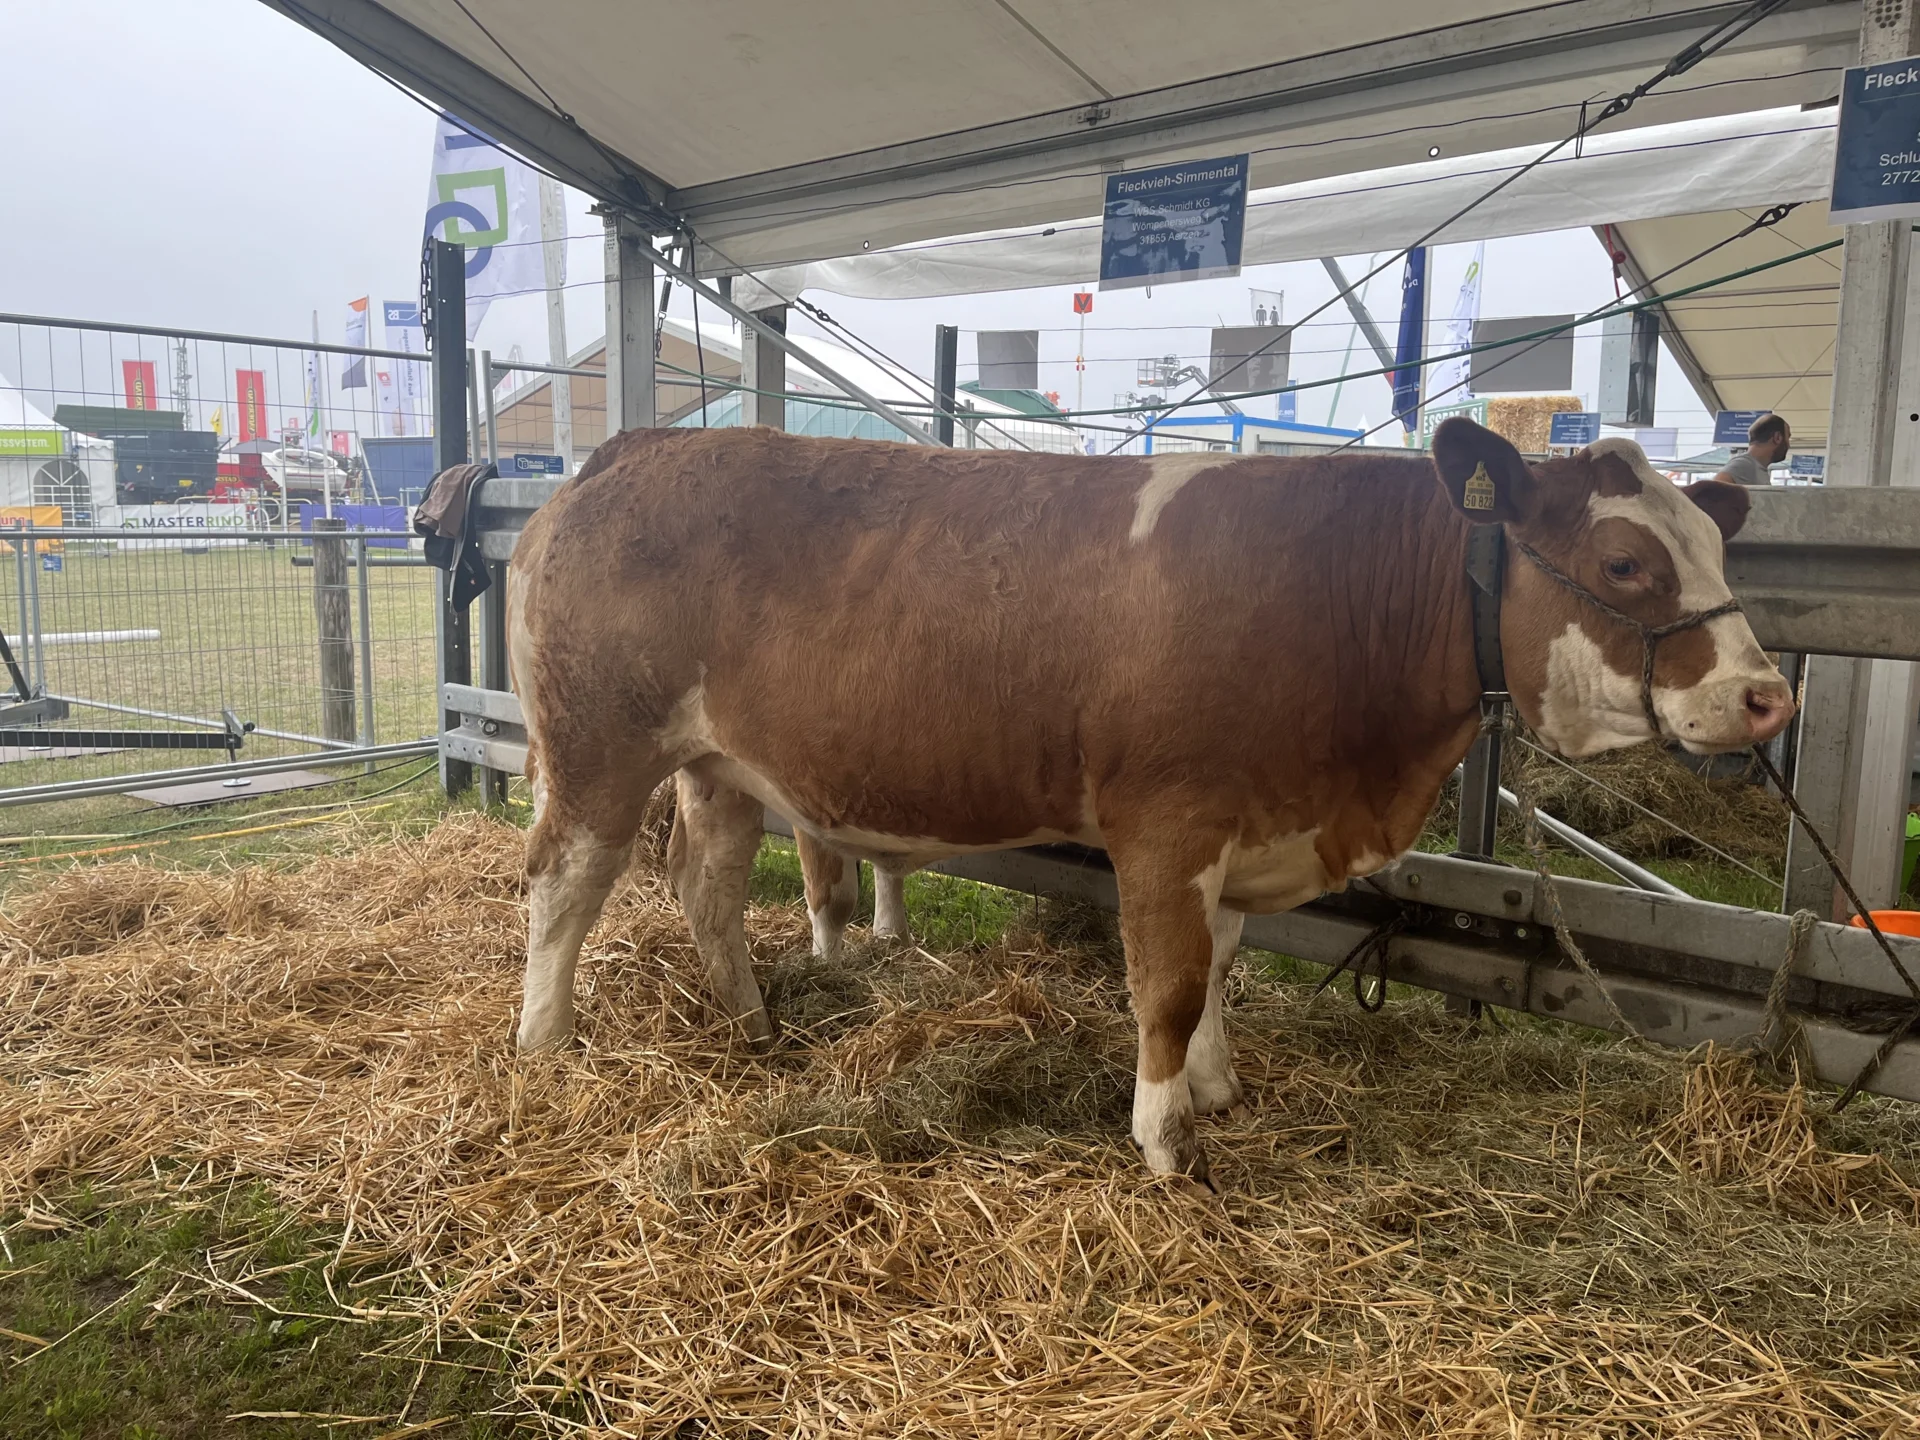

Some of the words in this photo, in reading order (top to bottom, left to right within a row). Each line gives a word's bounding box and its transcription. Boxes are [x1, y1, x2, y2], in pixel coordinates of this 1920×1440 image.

[1117, 164, 1239, 194] Fleckvieh-Simmental
[1158, 200, 1194, 214] Schmidt
[1195, 197, 1211, 209] KG
[142, 515, 244, 528] MASTERRIND
